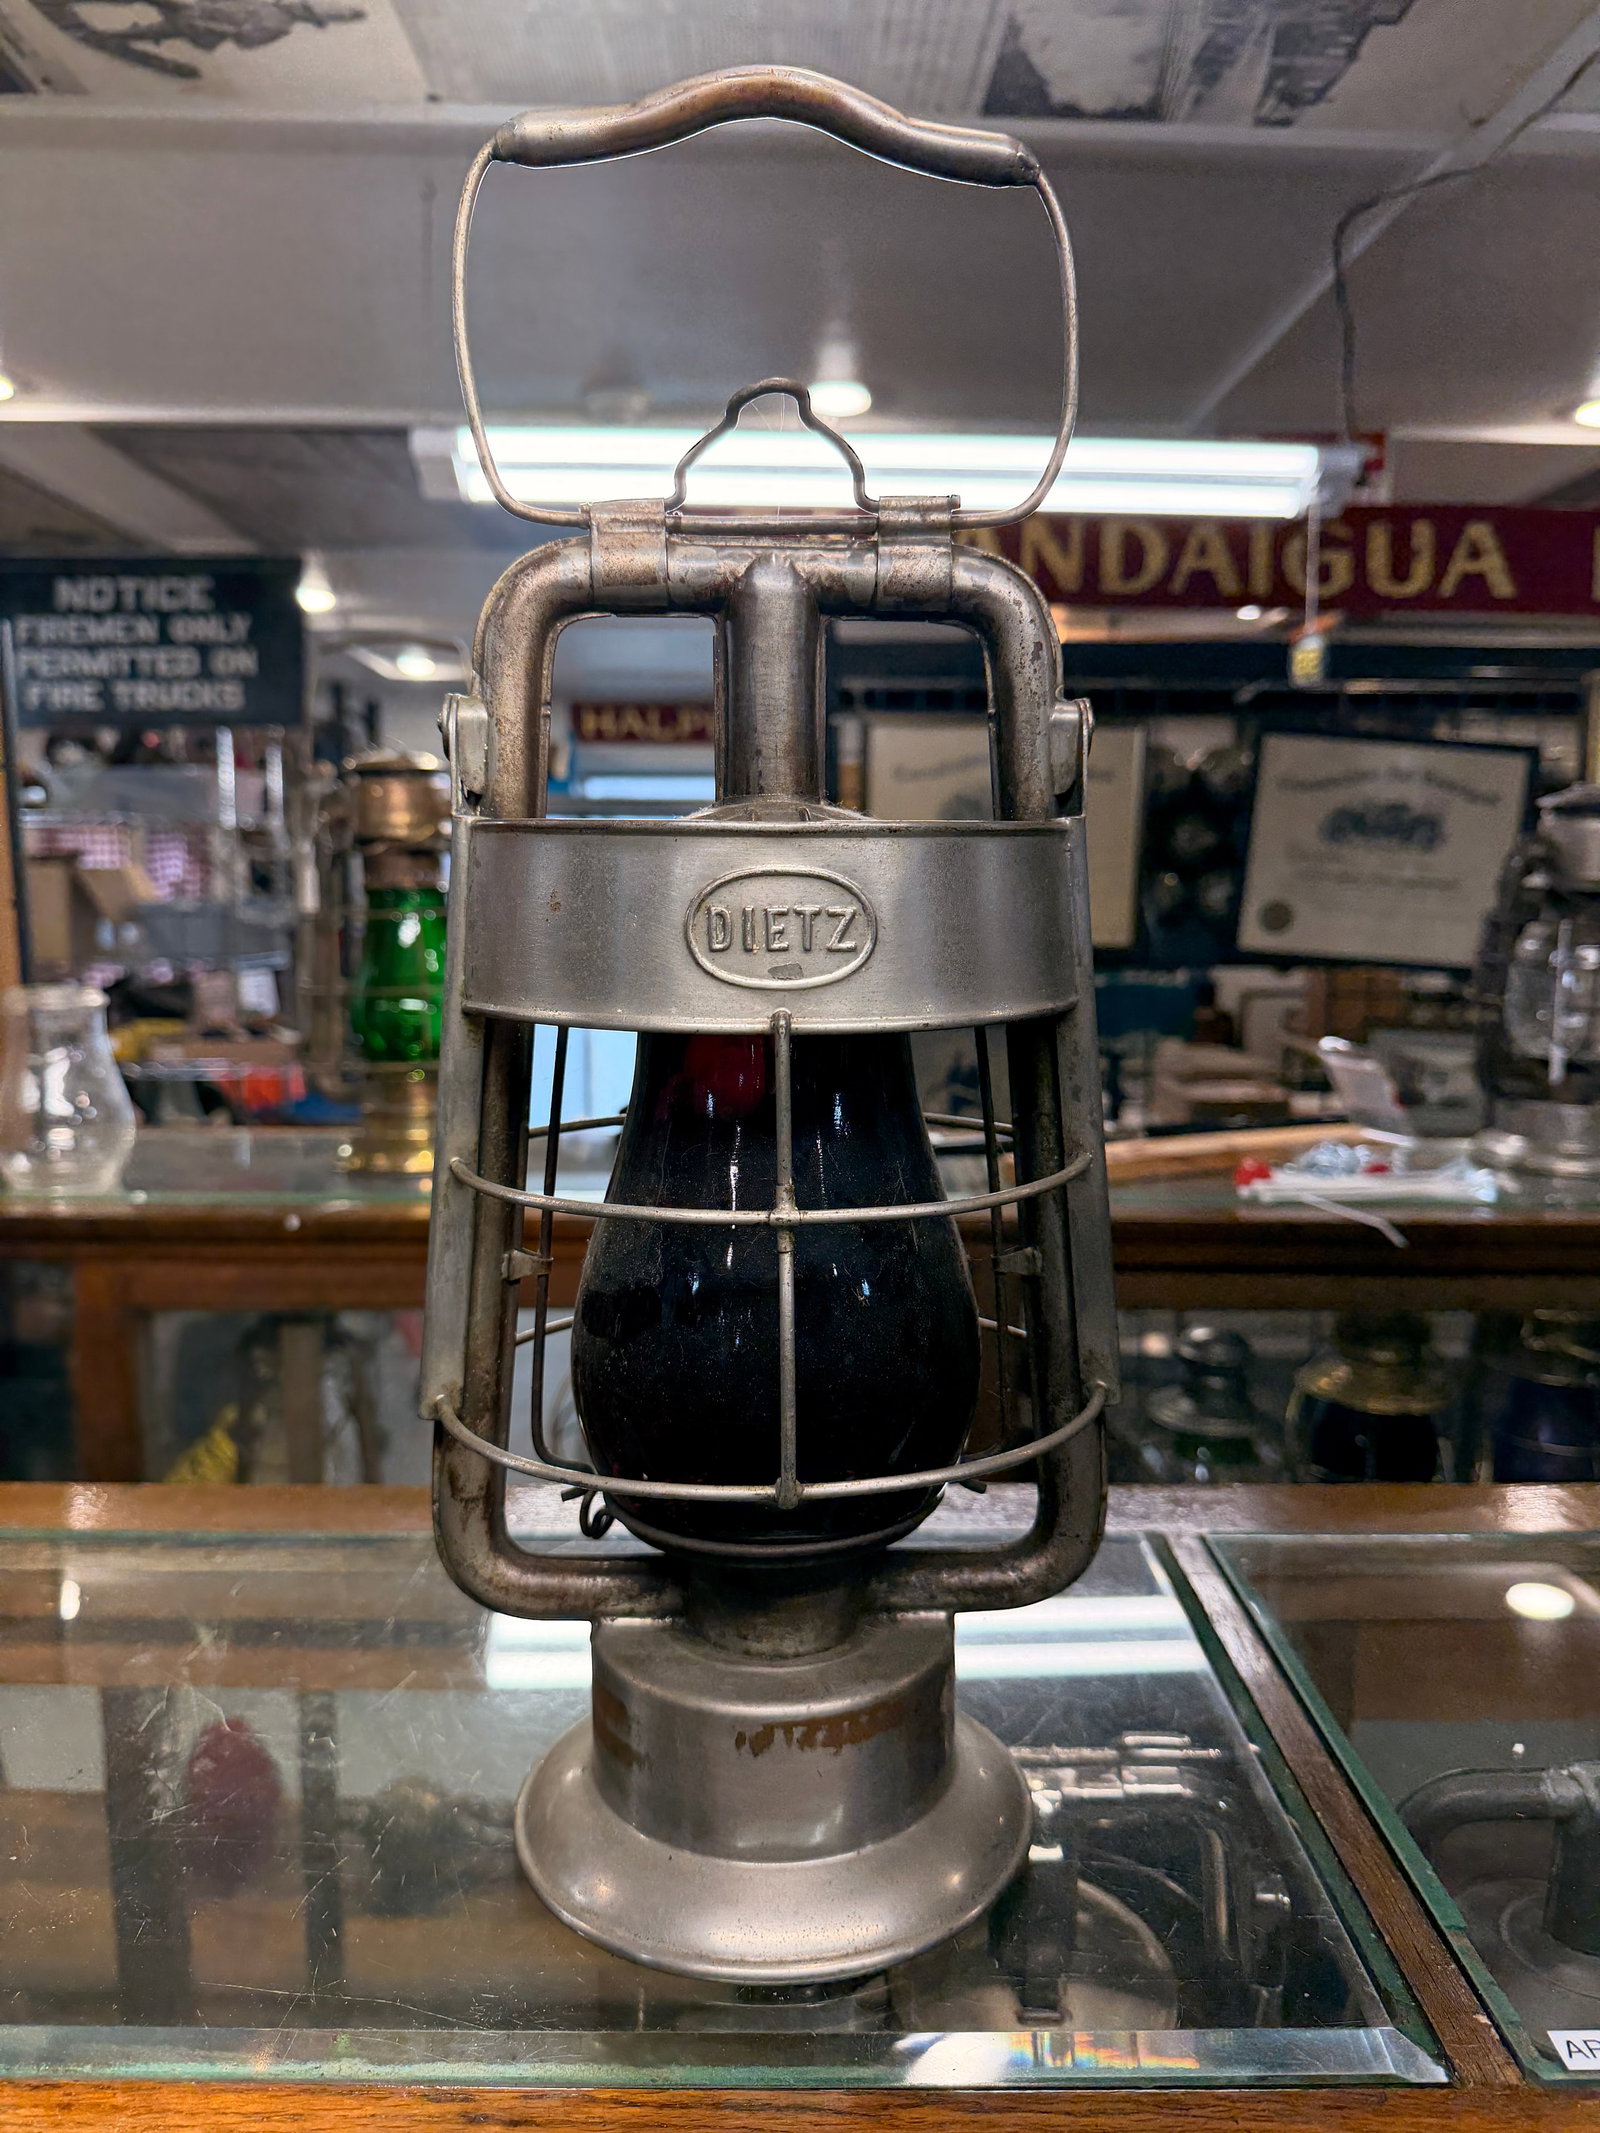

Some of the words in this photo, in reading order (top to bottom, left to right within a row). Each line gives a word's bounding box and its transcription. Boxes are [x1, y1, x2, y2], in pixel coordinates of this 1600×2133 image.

[54, 575, 214, 612] NOTICE
[15, 614, 159, 643] FIREMEN
[167, 614, 251, 643] ONLY
[16, 647, 201, 677] PERMITTED
[208, 646, 259, 677] ON
[23, 680, 105, 711] FIRE
[111, 679, 244, 711] TRUCKS
[706, 905, 858, 952] DIETZ
